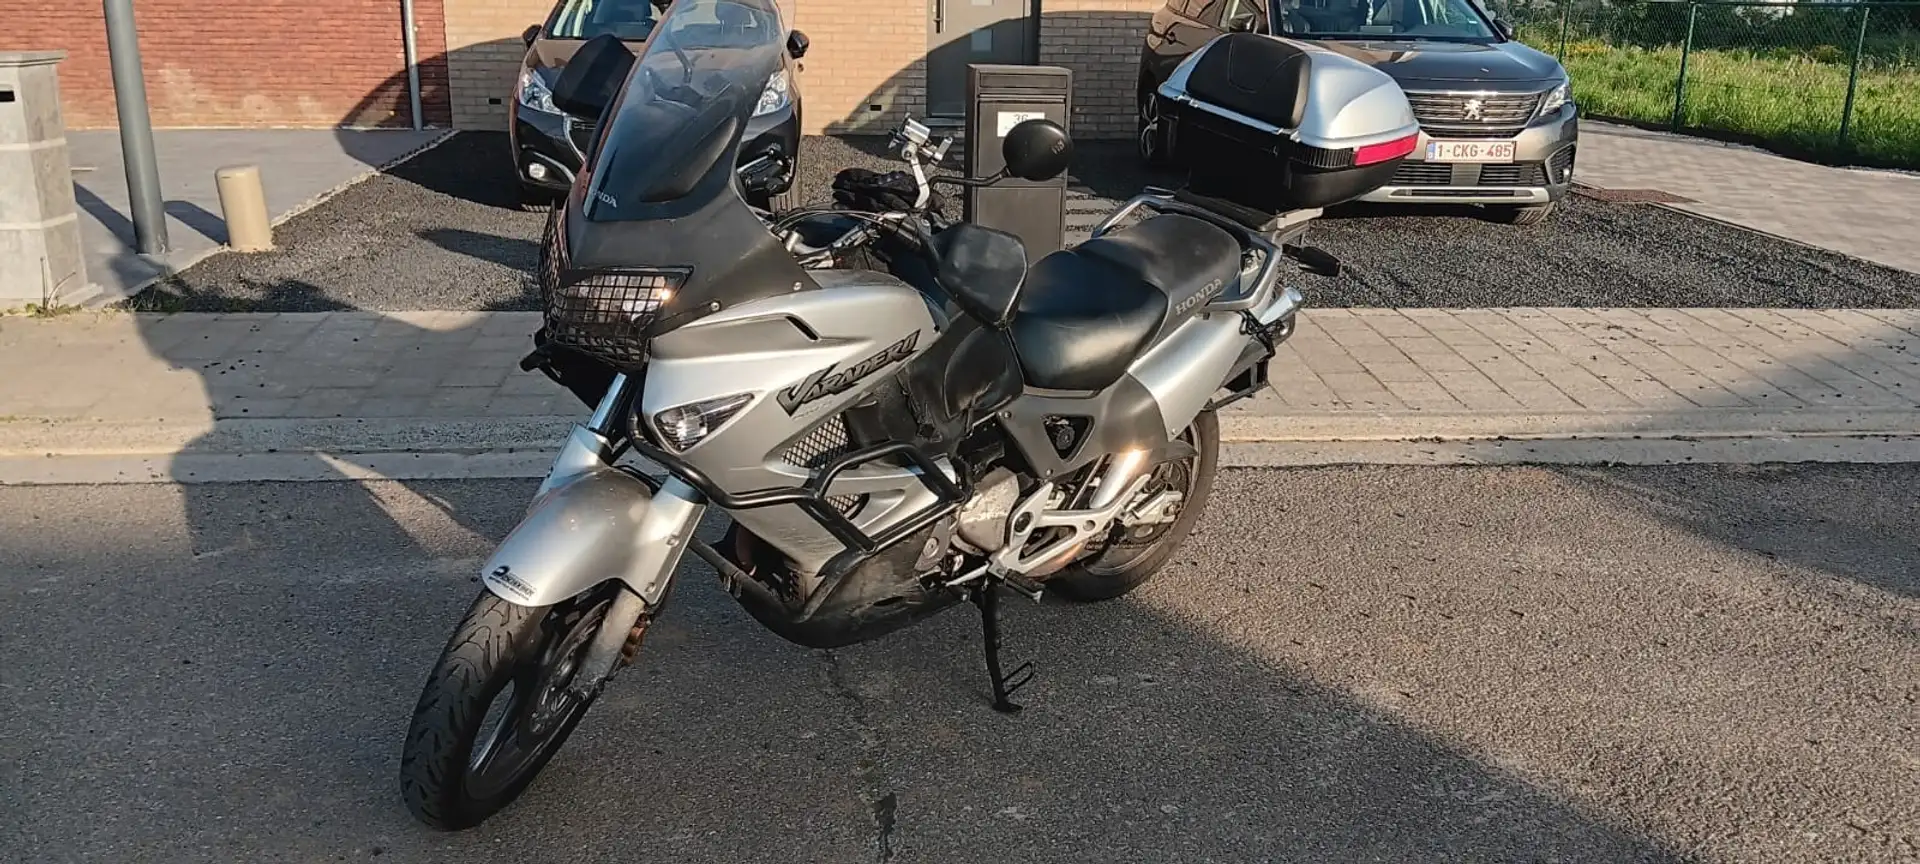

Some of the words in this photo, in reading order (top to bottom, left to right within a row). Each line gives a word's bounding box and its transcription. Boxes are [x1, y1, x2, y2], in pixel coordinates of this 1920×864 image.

[1438, 144, 1511, 158] 1-CKG-485
[1175, 278, 1222, 316] HONDA
[776, 328, 921, 417] VARADERO
